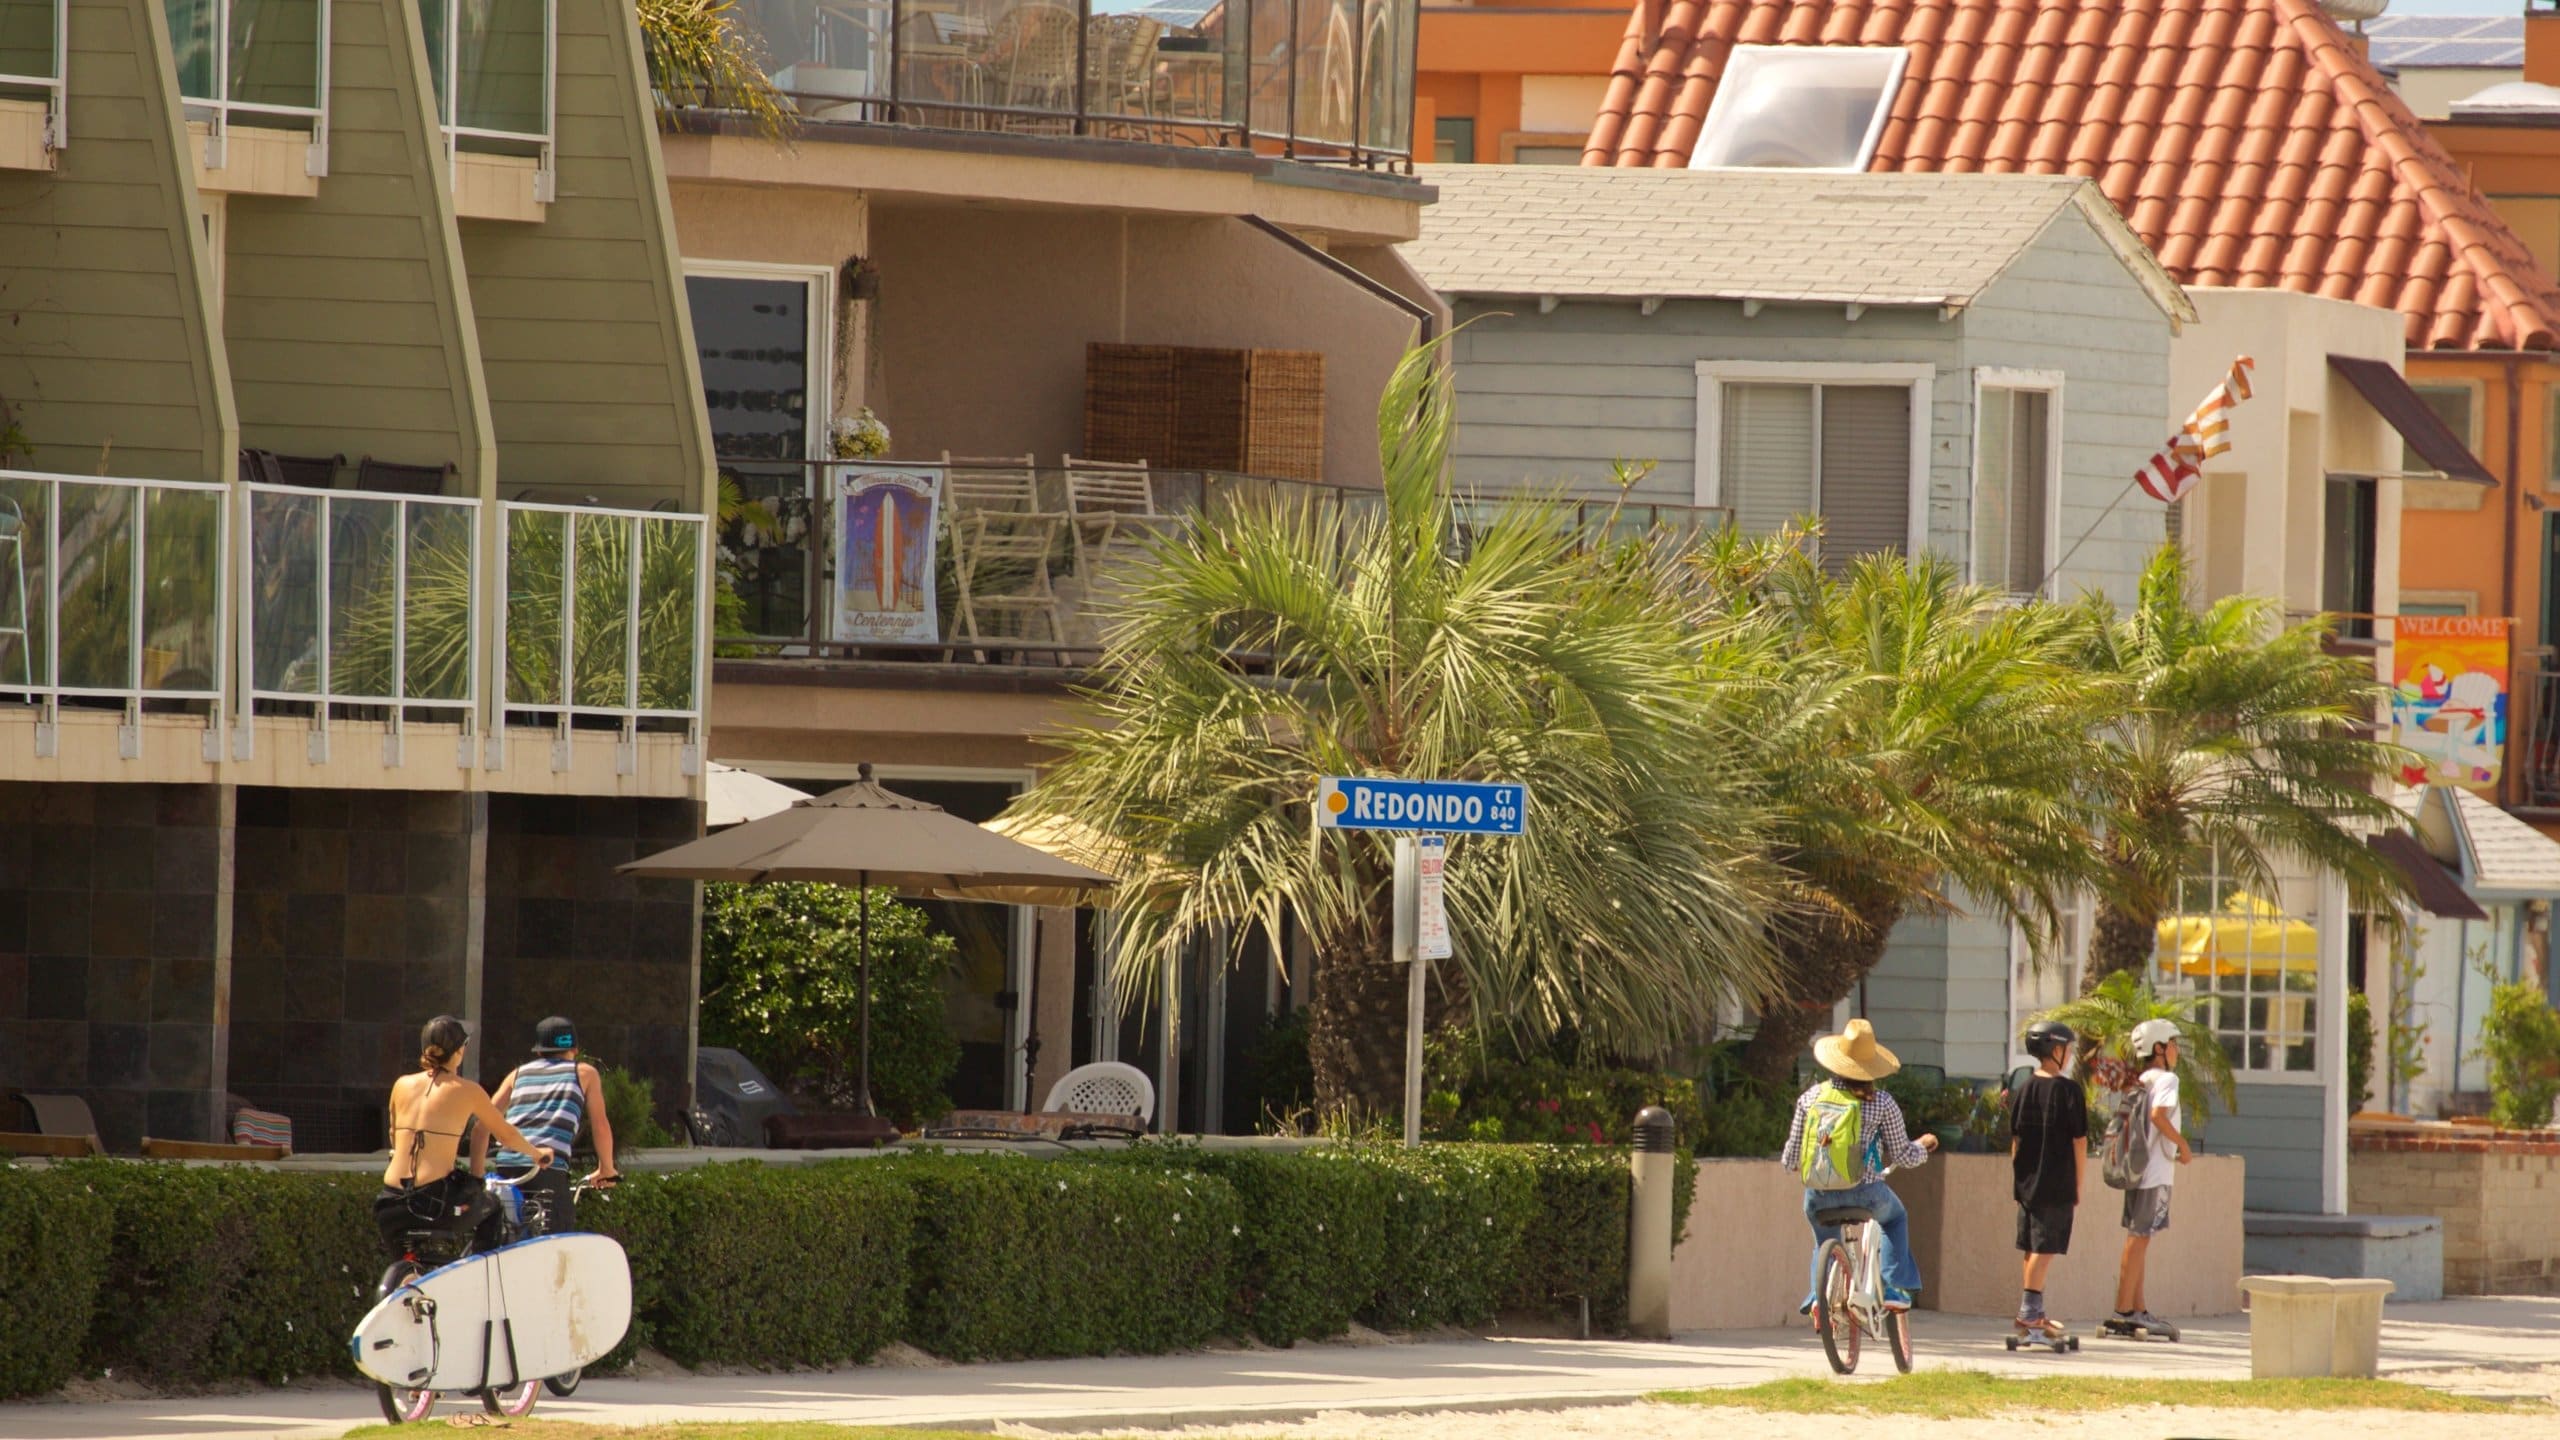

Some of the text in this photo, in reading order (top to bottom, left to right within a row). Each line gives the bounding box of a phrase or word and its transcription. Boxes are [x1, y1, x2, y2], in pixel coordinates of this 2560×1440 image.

[2401, 617, 2504, 636] WELCOME
[1354, 787, 1483, 823] REDONDO
[1495, 789, 1512, 804] CT
[1490, 805, 1516, 821] 840
